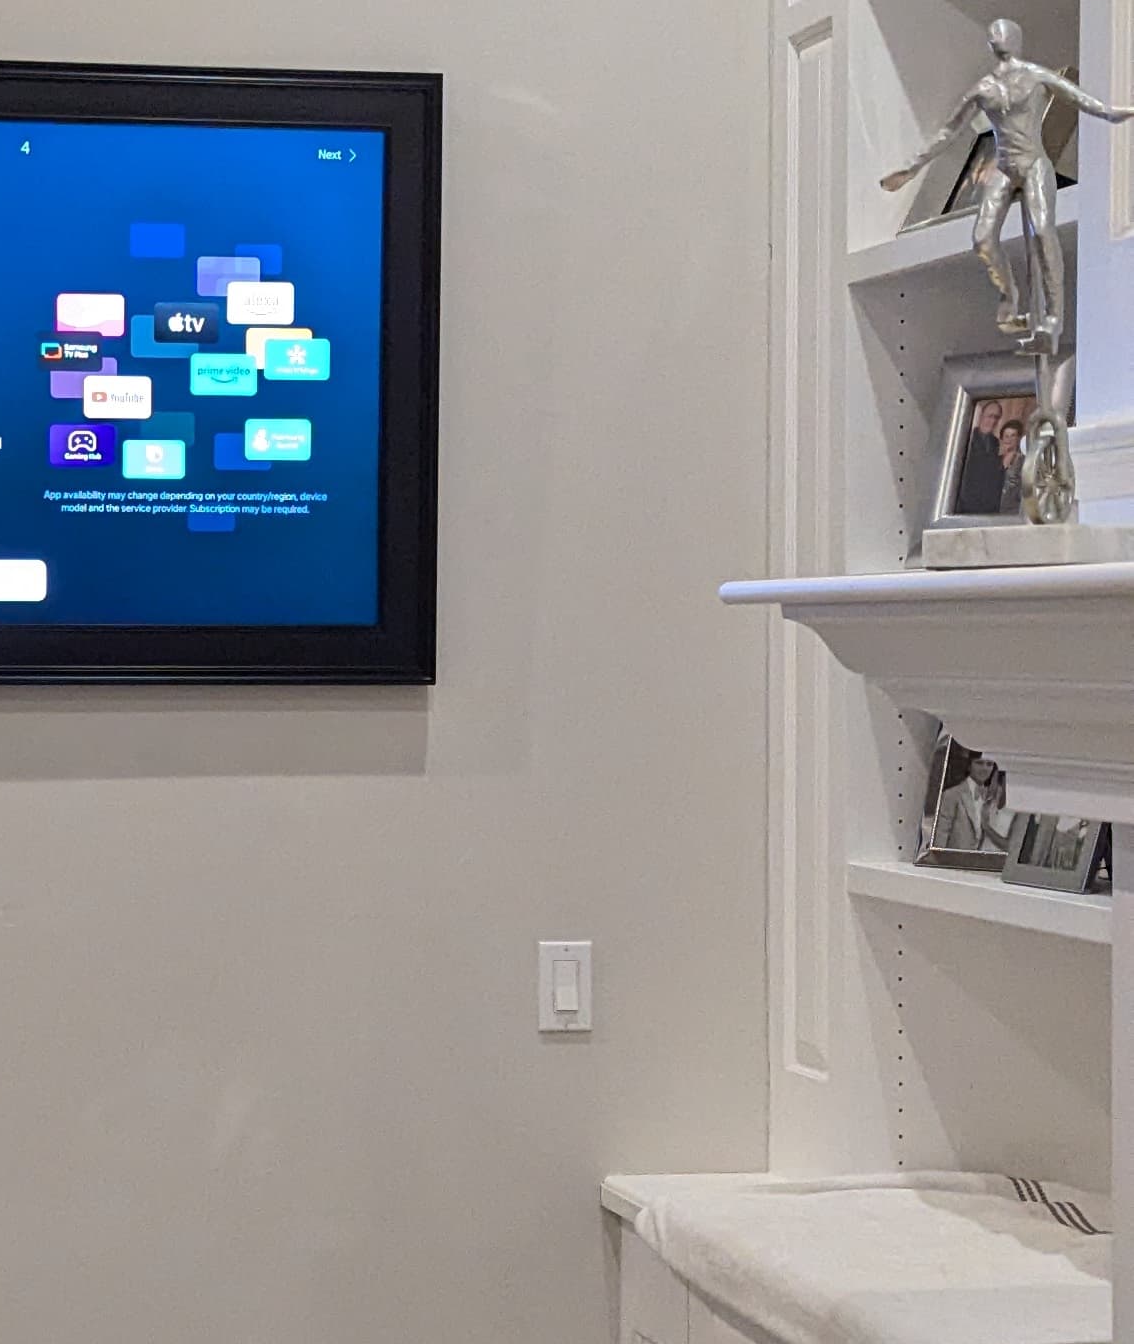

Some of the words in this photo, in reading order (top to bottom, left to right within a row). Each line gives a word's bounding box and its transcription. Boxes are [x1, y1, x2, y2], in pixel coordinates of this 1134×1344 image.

[20, 140, 31, 155] 4
[318, 148, 342, 161] Next
[185, 314, 205, 333] tv
[197, 365, 224, 376] prime
[226, 365, 251, 376] video
[110, 392, 145, 405] YouTube
[43, 490, 62, 501] App
[63, 490, 106, 502] availability
[107, 492, 127, 502] may
[127, 491, 159, 502] change
[159, 491, 204, 502] depending
[204, 493, 216, 502] on
[216, 493, 236, 502] your
[236, 492, 299, 503] country/region,
[299, 493, 328, 502] device
[61, 504, 88, 513] model
[88, 504, 105, 513] and
[106, 504, 120, 513] the
[121, 504, 152, 514] service
[189, 504, 241, 515] Subscription
[241, 505, 260, 516] may
[261, 505, 273, 514] be
[273, 505, 310, 516] required.
